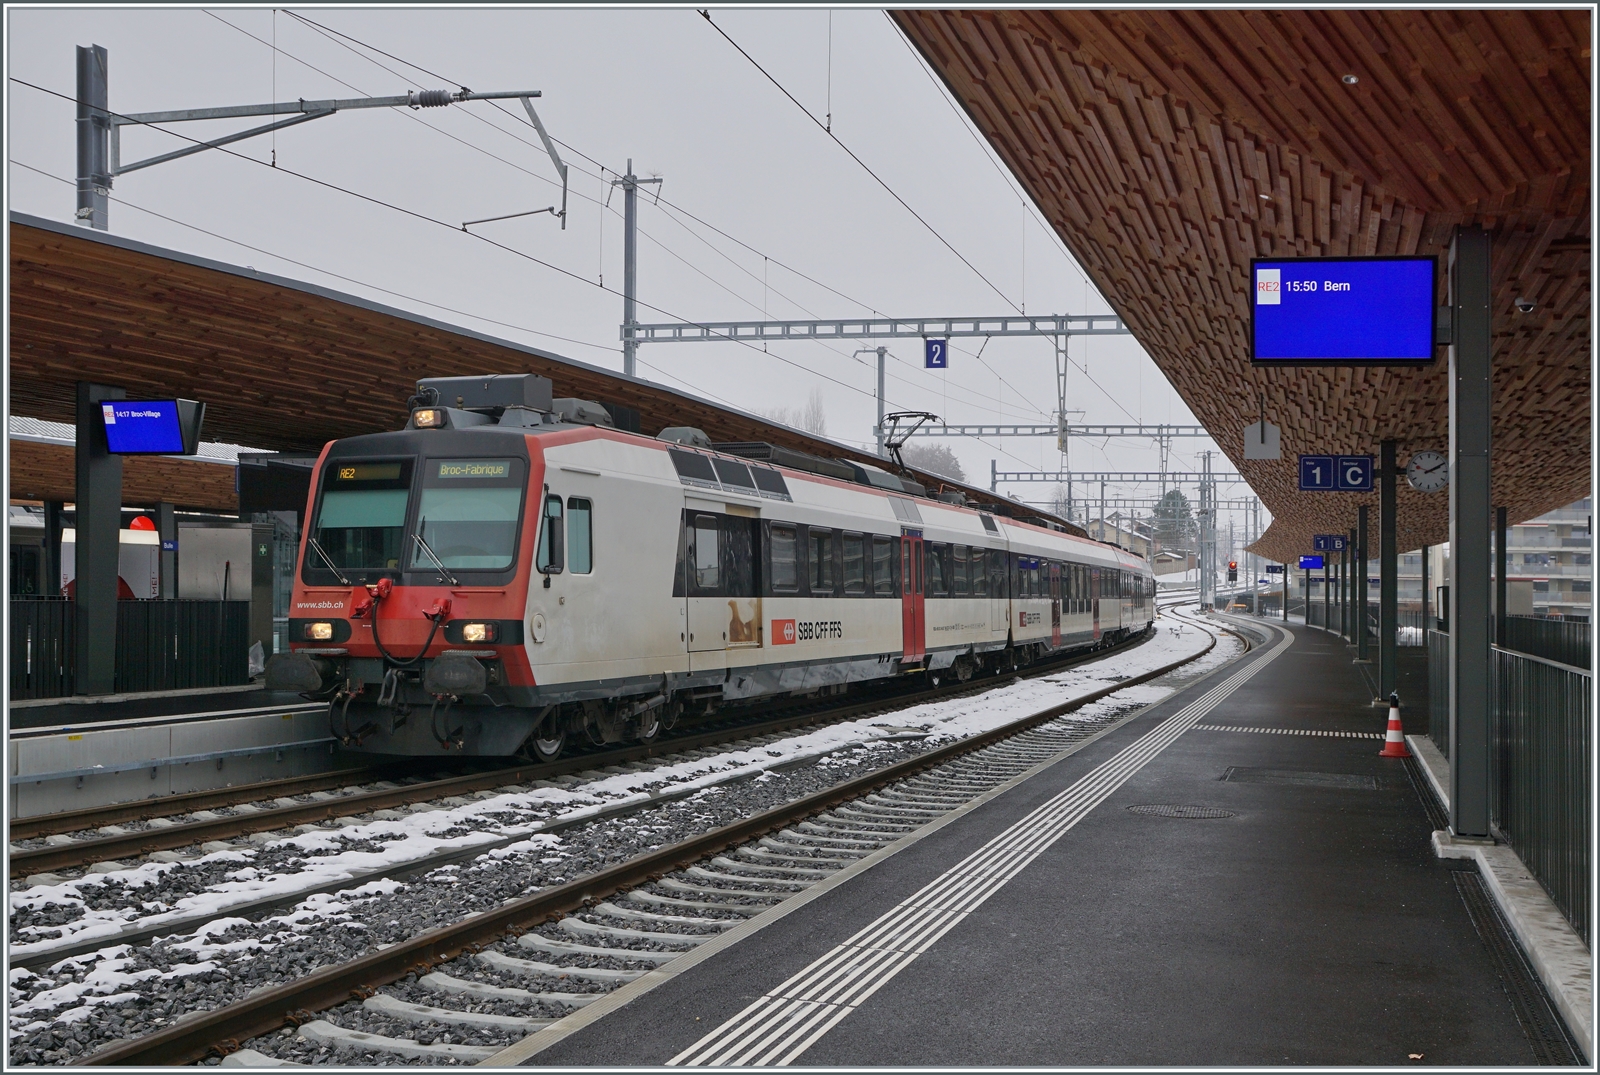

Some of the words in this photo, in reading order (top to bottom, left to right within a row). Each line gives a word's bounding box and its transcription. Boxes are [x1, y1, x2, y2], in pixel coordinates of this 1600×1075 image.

[1258, 281, 1279, 292] RE2
[1286, 281, 1317, 292] 15:50
[1324, 280, 1351, 291] Bern
[932, 344, 941, 364] 2
[340, 468, 355, 479] RE2
[440, 464, 504, 476] Broc-Fabrique
[1312, 466, 1321, 485] 1
[1346, 466, 1363, 485] C
[1319, 540, 1324, 549] 1
[1335, 540, 1343, 549] B
[297, 600, 344, 609] www.sbb.ch
[798, 622, 814, 640] SBB
[815, 621, 828, 640] CFF
[829, 621, 842, 638] FFS
